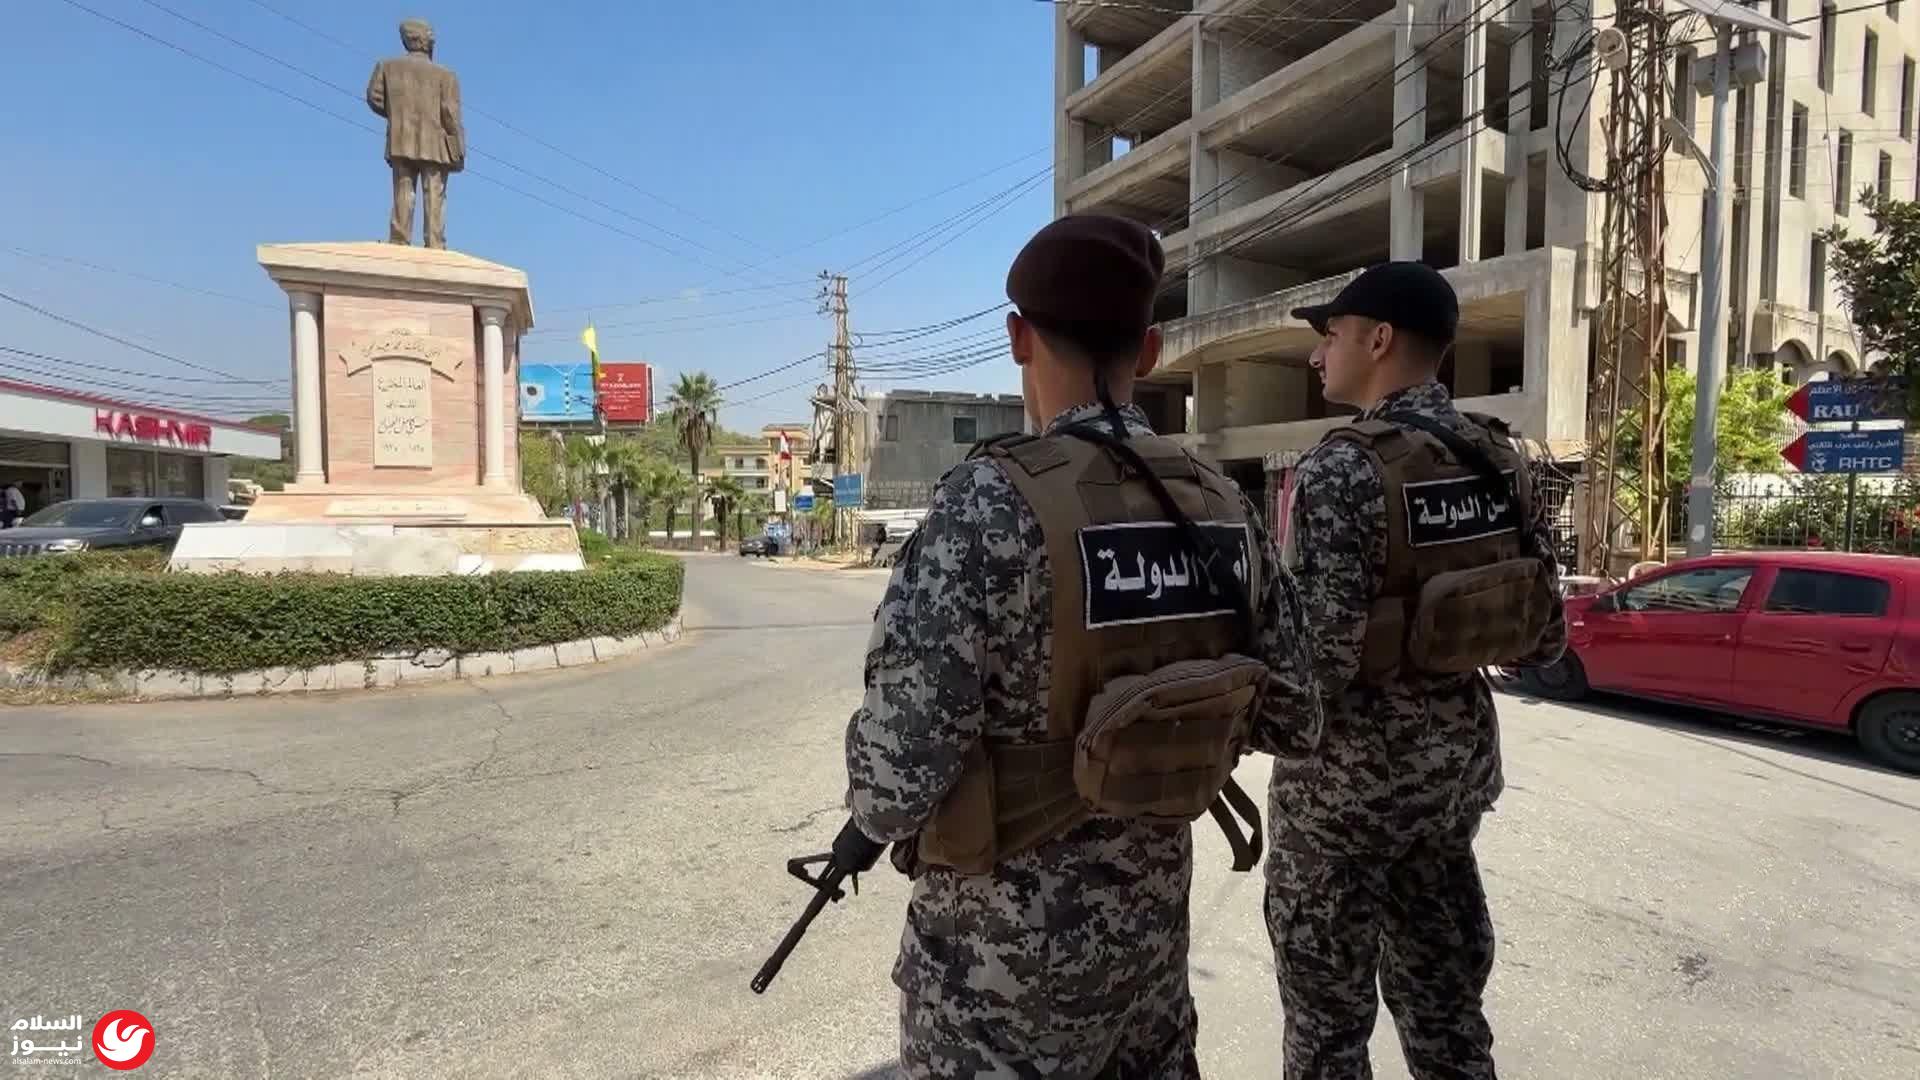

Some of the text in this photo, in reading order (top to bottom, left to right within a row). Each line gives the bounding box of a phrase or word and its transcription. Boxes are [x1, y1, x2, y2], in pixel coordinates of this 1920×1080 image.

[1814, 404, 1859, 419] RAU
[1839, 456, 1892, 469] RHTC
[1414, 493, 1481, 529] الدولة
[1097, 547, 1199, 600] الدولة
